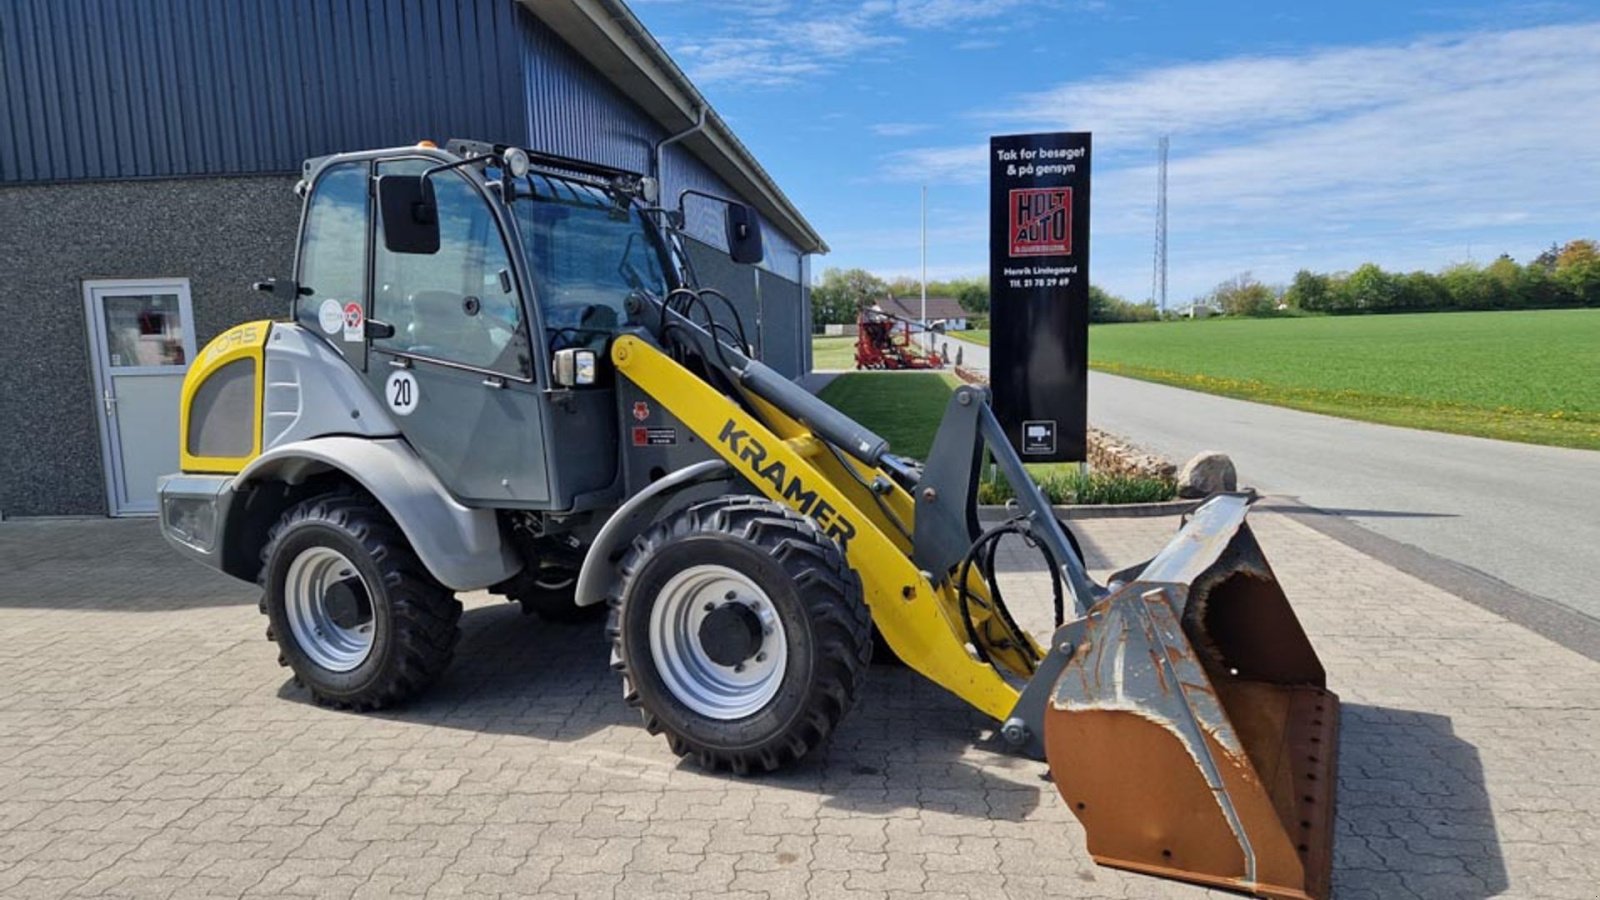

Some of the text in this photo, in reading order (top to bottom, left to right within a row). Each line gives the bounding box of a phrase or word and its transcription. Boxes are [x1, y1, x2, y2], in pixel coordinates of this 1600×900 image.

[997, 146, 1085, 160] Tak for besøget
[1007, 163, 1076, 177] & på gensyn
[1017, 192, 1065, 226] HOLT
[1015, 208, 1066, 242] AUTO
[1003, 266, 1032, 276] Henrik
[393, 378, 412, 406] 20
[718, 418, 857, 552] KRAMER
